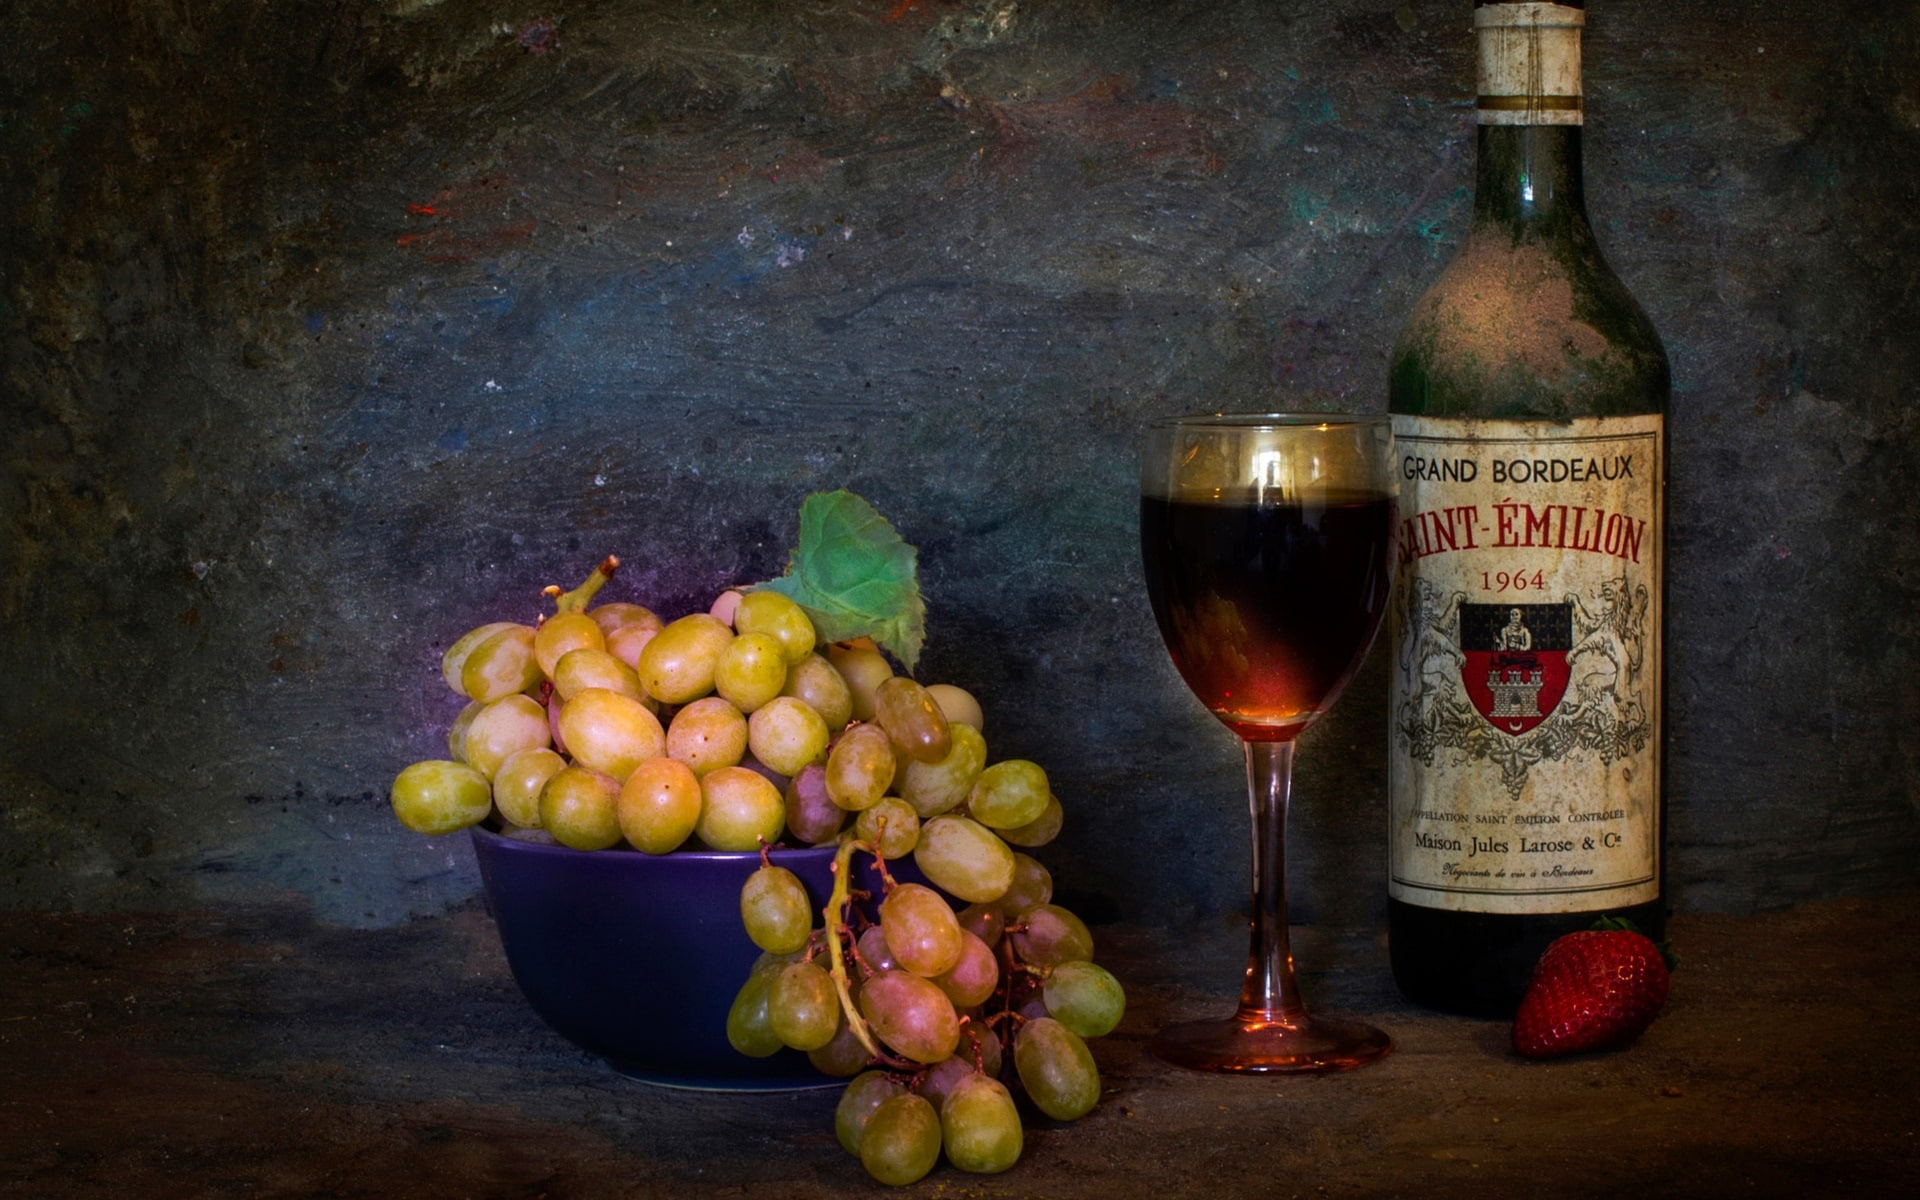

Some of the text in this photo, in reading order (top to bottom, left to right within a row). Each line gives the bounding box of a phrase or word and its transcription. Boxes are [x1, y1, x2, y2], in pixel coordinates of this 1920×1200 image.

[1403, 455, 1634, 483] GRAND BORDEAUX
[1481, 569, 1545, 592] 1964
[1476, 814, 1507, 825] SAINT
[1415, 832, 1462, 851] Maison
[1469, 837, 1509, 857] Jules
[1520, 838, 1573, 853] Larose
[1582, 836, 1595, 850] &
[1495, 868, 1506, 878] de
